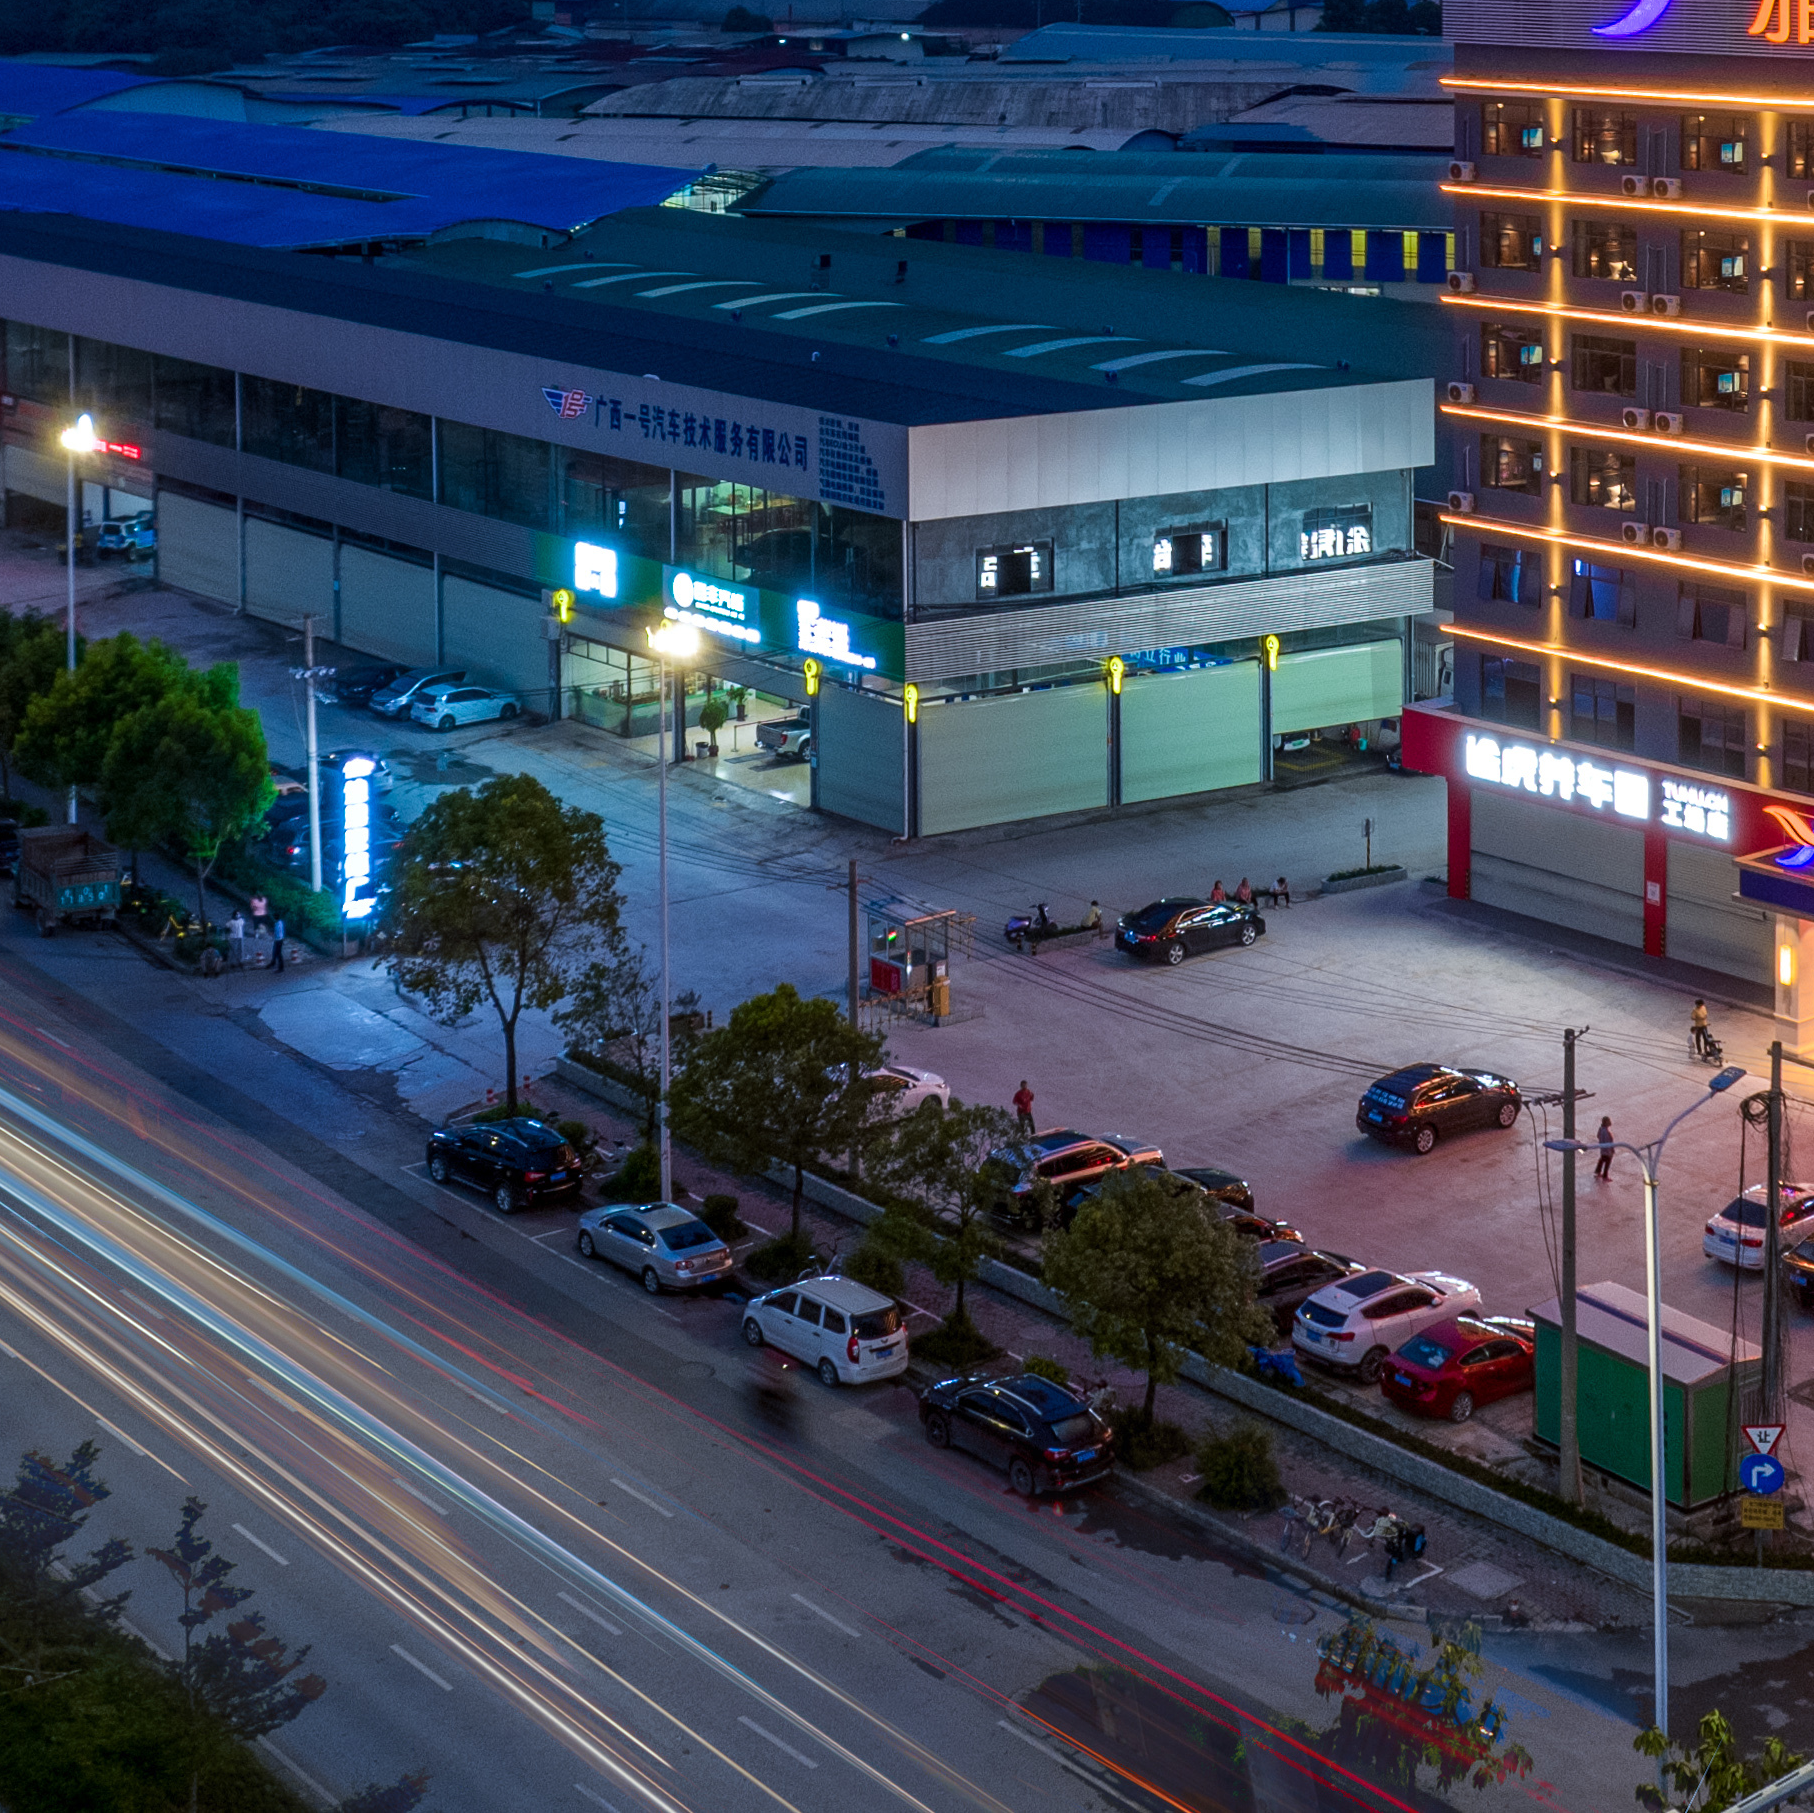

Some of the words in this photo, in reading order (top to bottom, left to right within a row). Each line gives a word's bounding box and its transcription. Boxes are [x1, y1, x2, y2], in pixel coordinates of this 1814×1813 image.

[595, 395, 808, 472] 广西一号汽车技术服务有限公司
[1757, 1430, 1771, 1443] 让
